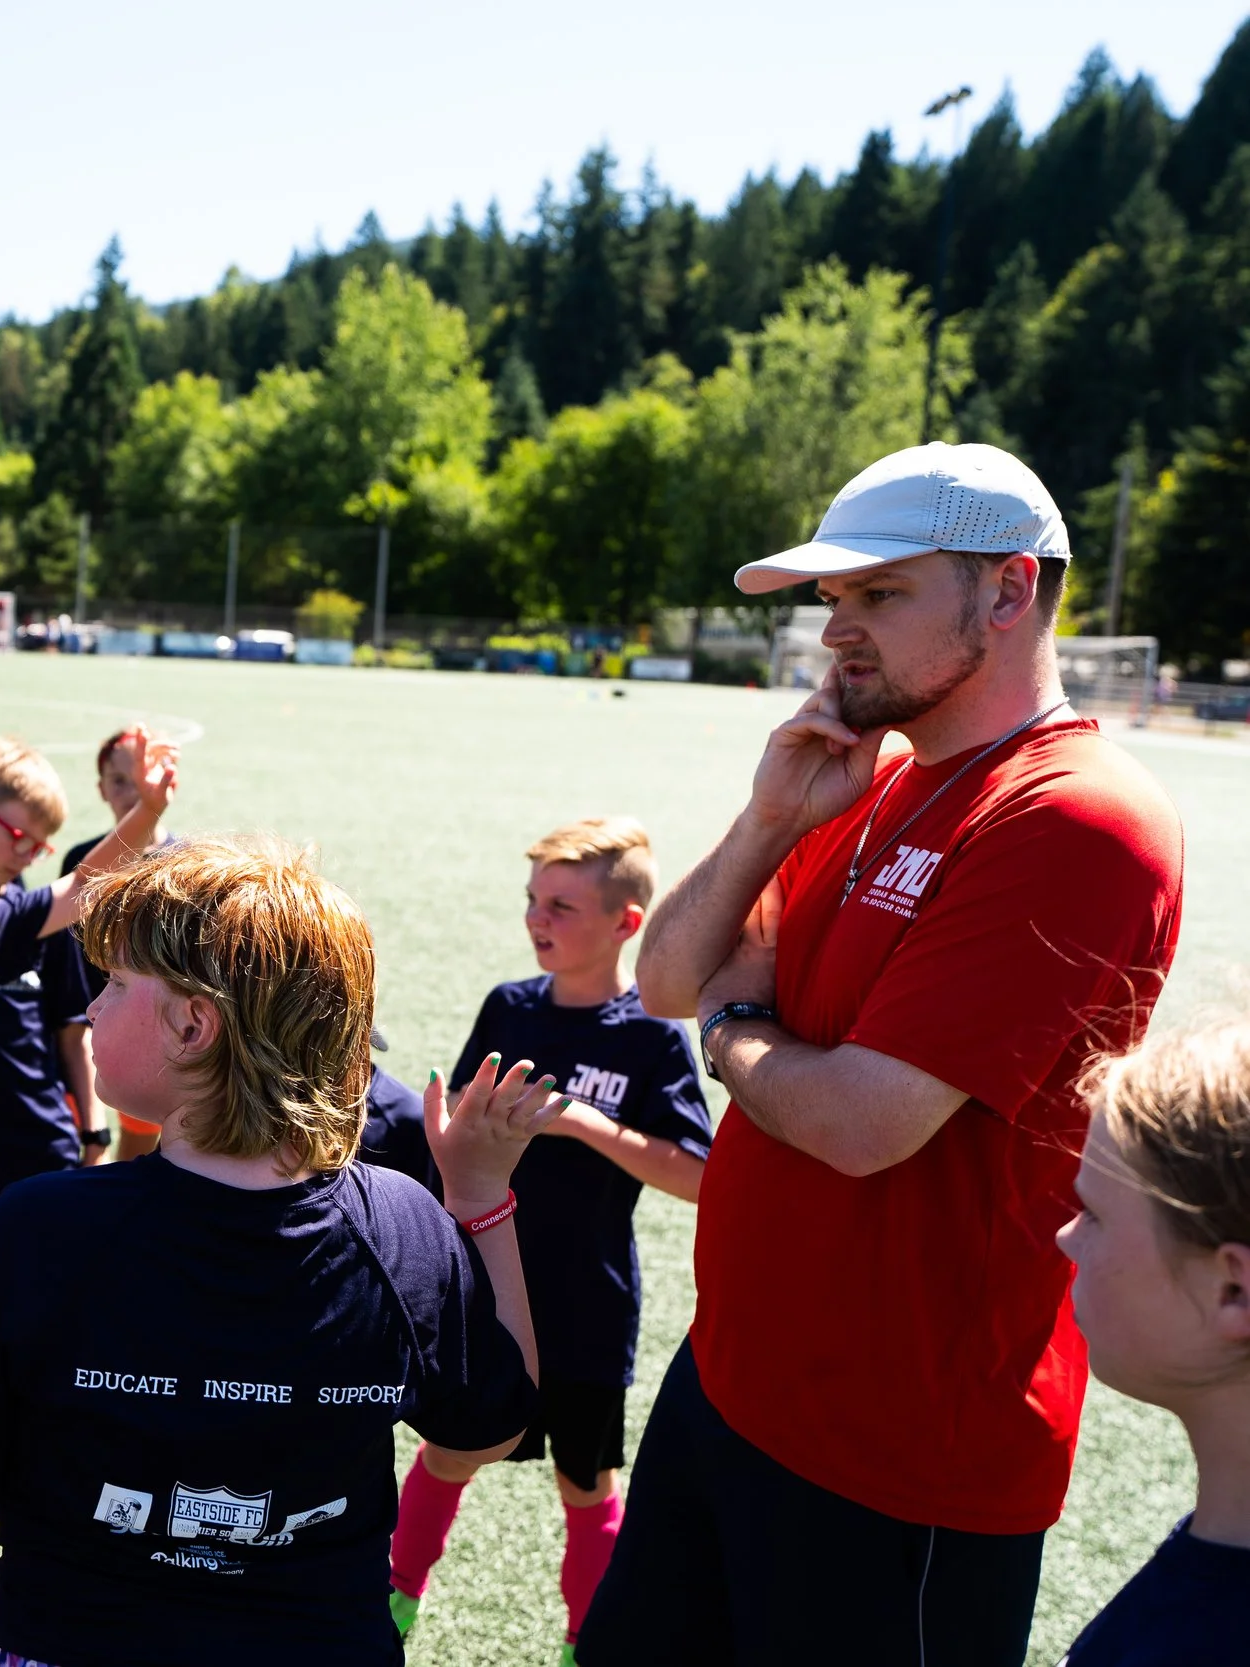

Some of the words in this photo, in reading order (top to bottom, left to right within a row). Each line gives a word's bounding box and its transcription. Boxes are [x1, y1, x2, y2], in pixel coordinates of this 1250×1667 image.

[869, 898, 894, 911] SOCCER
[888, 893, 915, 908] MORRIS
[471, 1203, 513, 1231] Connected
[74, 1368, 178, 1396] EDUCATE
[203, 1379, 293, 1404] INSPIRE
[317, 1384, 405, 1404] SUPPORT
[176, 1499, 240, 1524] EASTSIDE
[245, 1508, 262, 1526] FC
